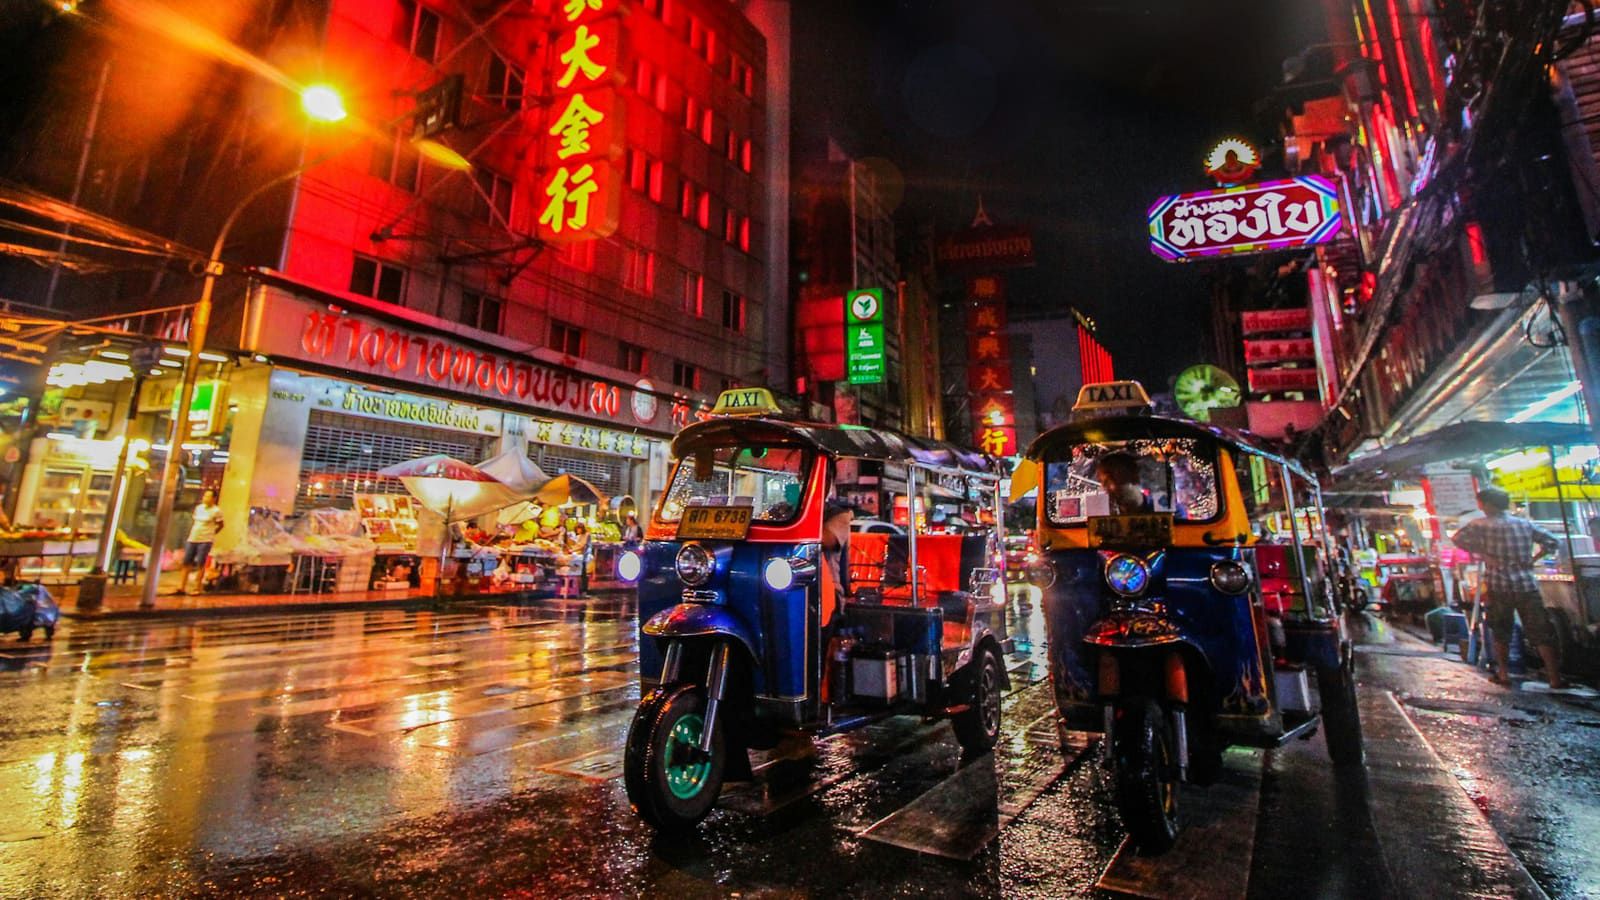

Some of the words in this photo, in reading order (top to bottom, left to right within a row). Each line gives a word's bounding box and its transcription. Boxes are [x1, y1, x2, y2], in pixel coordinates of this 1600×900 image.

[723, 391, 760, 408] TAXI
[1088, 384, 1134, 401] TAXI
[714, 509, 747, 525] 6738
